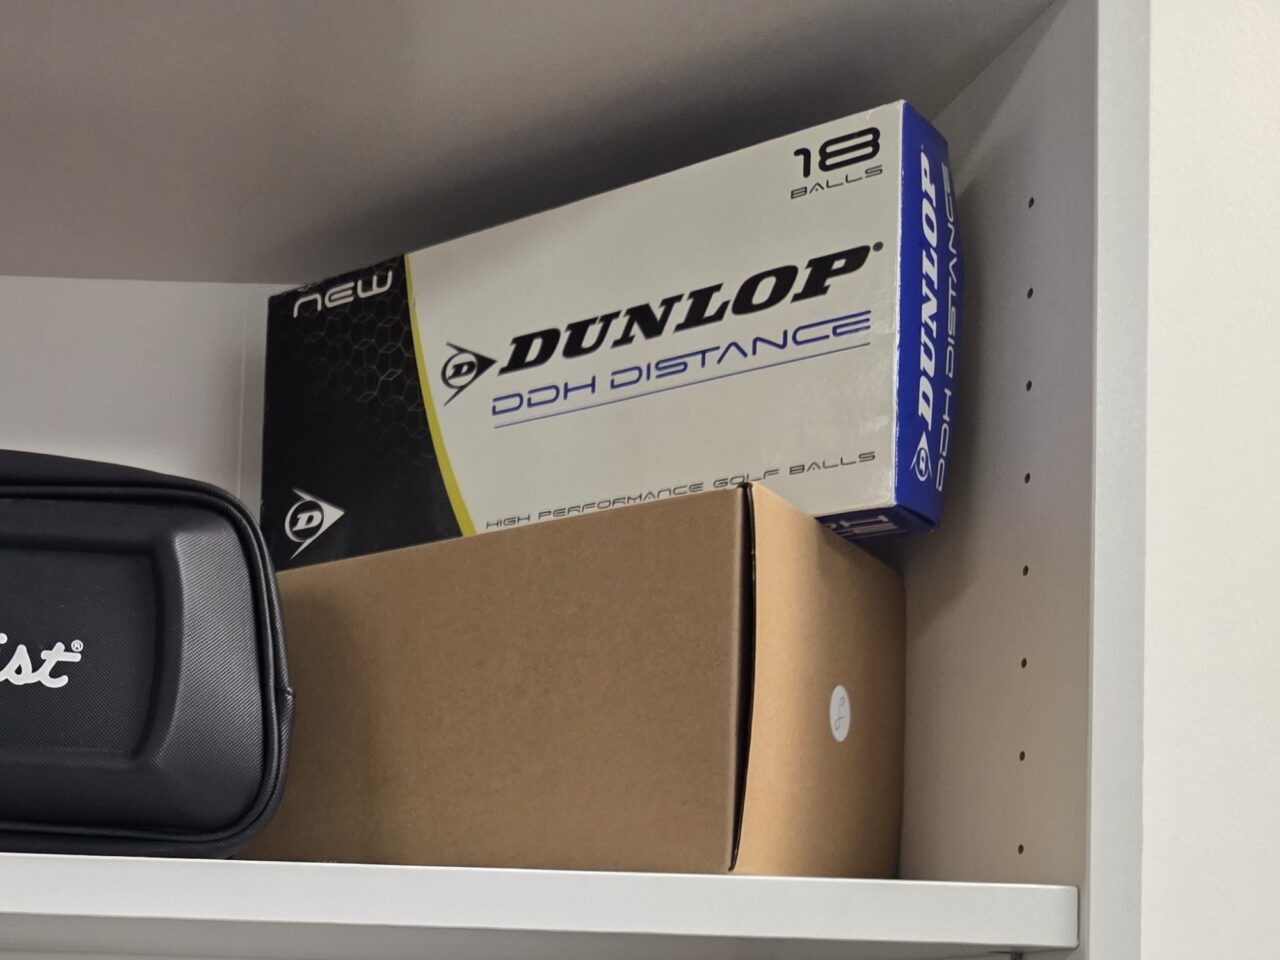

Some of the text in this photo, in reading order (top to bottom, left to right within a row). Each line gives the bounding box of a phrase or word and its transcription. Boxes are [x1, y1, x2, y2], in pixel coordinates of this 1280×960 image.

[790, 164, 883, 199] BALLS
[794, 127, 880, 178] 18
[498, 245, 872, 376] DUNLOP
[918, 152, 938, 431] DUNLOP
[936, 161, 957, 492] DDH DISTANCE
[491, 310, 871, 416] DDH DISTANCE
[486, 450, 876, 530] HIGH PERFORMANCE GOLF BALLS
